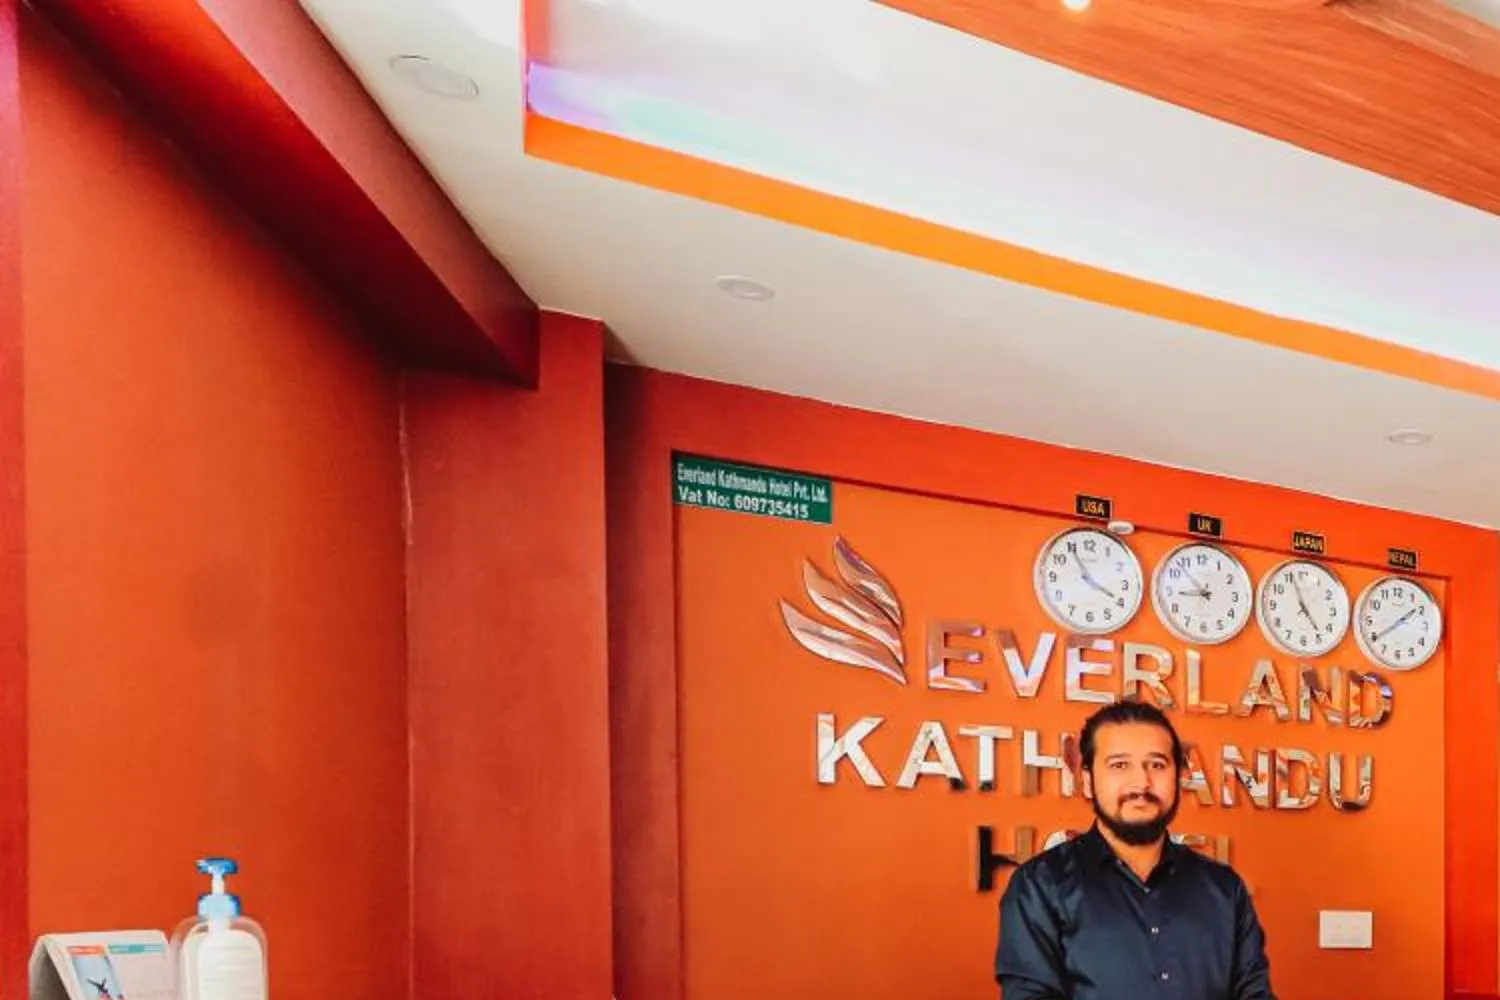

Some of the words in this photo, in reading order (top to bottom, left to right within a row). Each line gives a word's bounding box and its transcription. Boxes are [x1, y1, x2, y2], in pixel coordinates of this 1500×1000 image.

[677, 463, 717, 483] Everland
[718, 469, 767, 493] Kathmandu
[769, 478, 792, 498] Hotel
[678, 485, 702, 503] Vat
[706, 490, 731, 508] No:
[734, 494, 809, 519] 609735415
[1081, 500, 1105, 515] USA
[1197, 518, 1212, 532] UK
[1084, 540, 1097, 553] 12
[1053, 554, 1067, 566] 10
[1169, 568, 1180, 578] 10
[1273, 583, 1284, 595] 10
[1380, 589, 1389, 600] 11
[1393, 587, 1403, 598] 12
[927, 620, 1393, 729] EVERLAND
[816, 712, 1373, 813] KATHANDU
